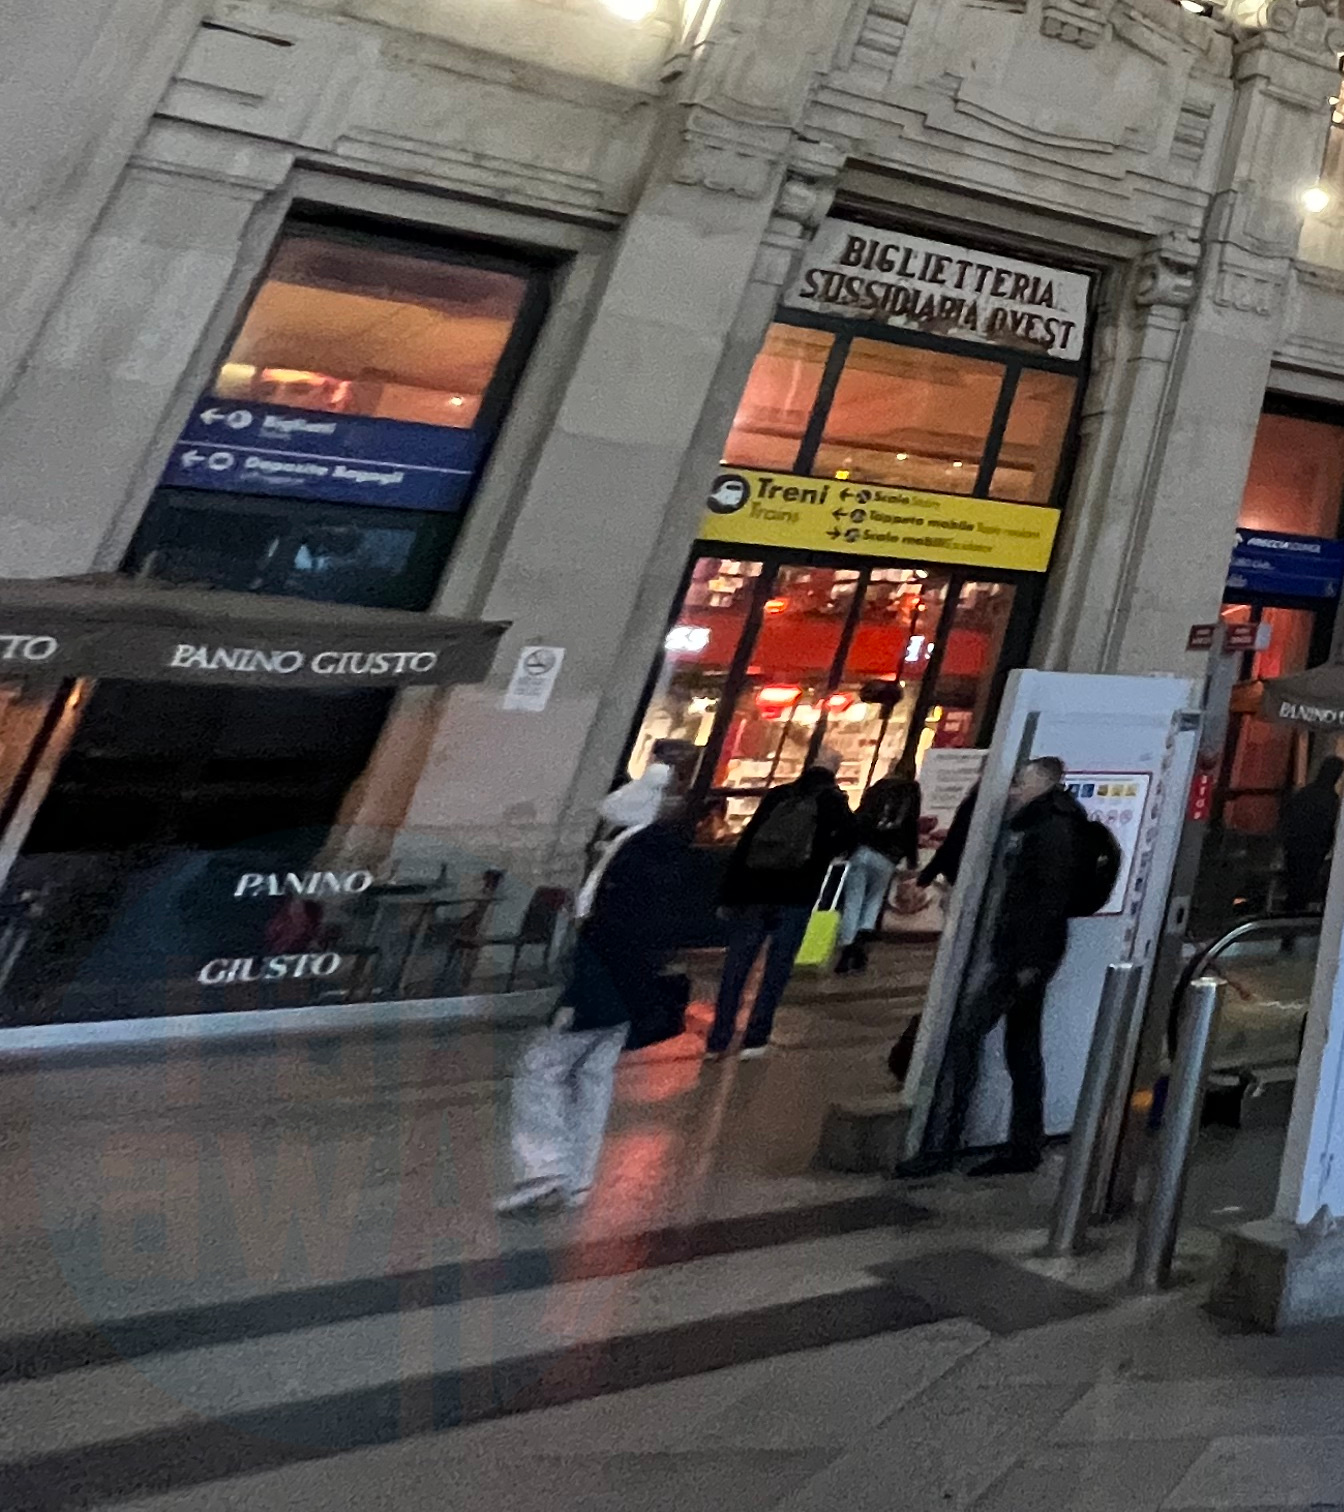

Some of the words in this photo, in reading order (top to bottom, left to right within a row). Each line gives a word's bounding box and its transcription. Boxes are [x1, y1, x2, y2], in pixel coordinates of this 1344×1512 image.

[839, 234, 1054, 309] BIGLIETTERIA
[798, 267, 980, 331] SUSSIDIARIA
[986, 306, 1077, 350] OVEST
[757, 477, 830, 505] Treni
[169, 643, 304, 675] PANINO
[310, 651, 438, 676] GIUSTO
[233, 869, 374, 898] PANINO
[197, 951, 343, 985] GIUSTO
